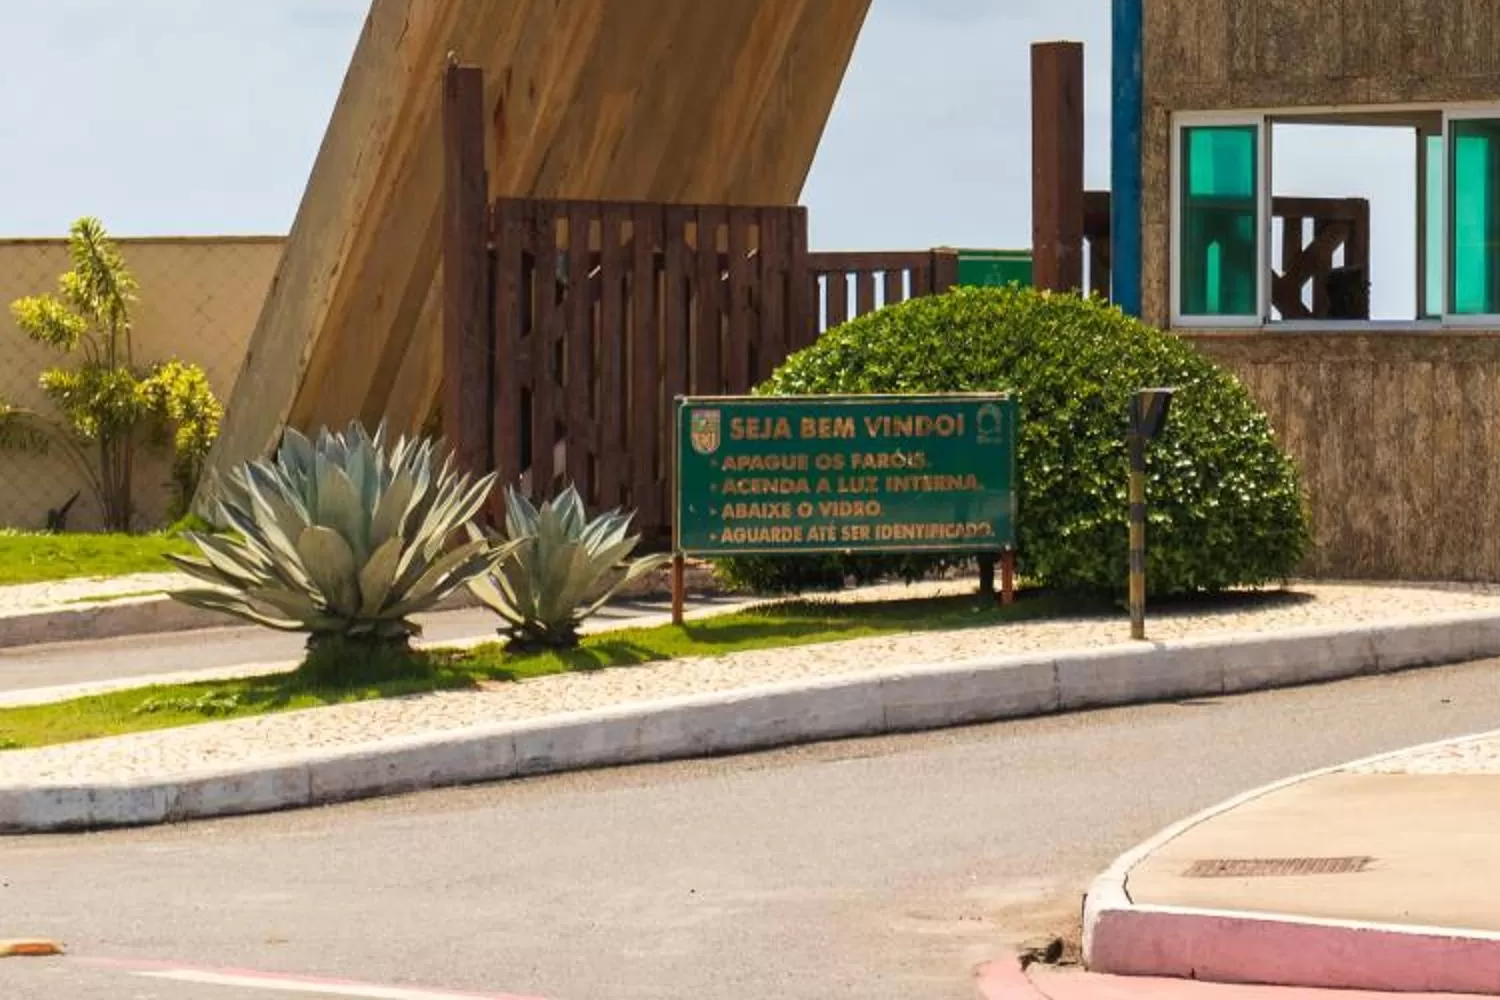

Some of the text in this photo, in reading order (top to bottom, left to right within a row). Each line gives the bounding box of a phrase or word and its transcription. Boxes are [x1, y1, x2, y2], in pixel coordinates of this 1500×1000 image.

[730, 416, 792, 441] SEJA
[799, 416, 856, 439] BEM
[721, 455, 808, 471] APAGUE
[815, 453, 845, 471] OS
[722, 478, 809, 495] ACENDA
[815, 478, 831, 493] A
[837, 476, 879, 493] LUZ
[722, 502, 792, 519] ABAIXE
[797, 501, 813, 517] O
[721, 525, 803, 542] AGUARDE
[841, 523, 870, 540] SER
